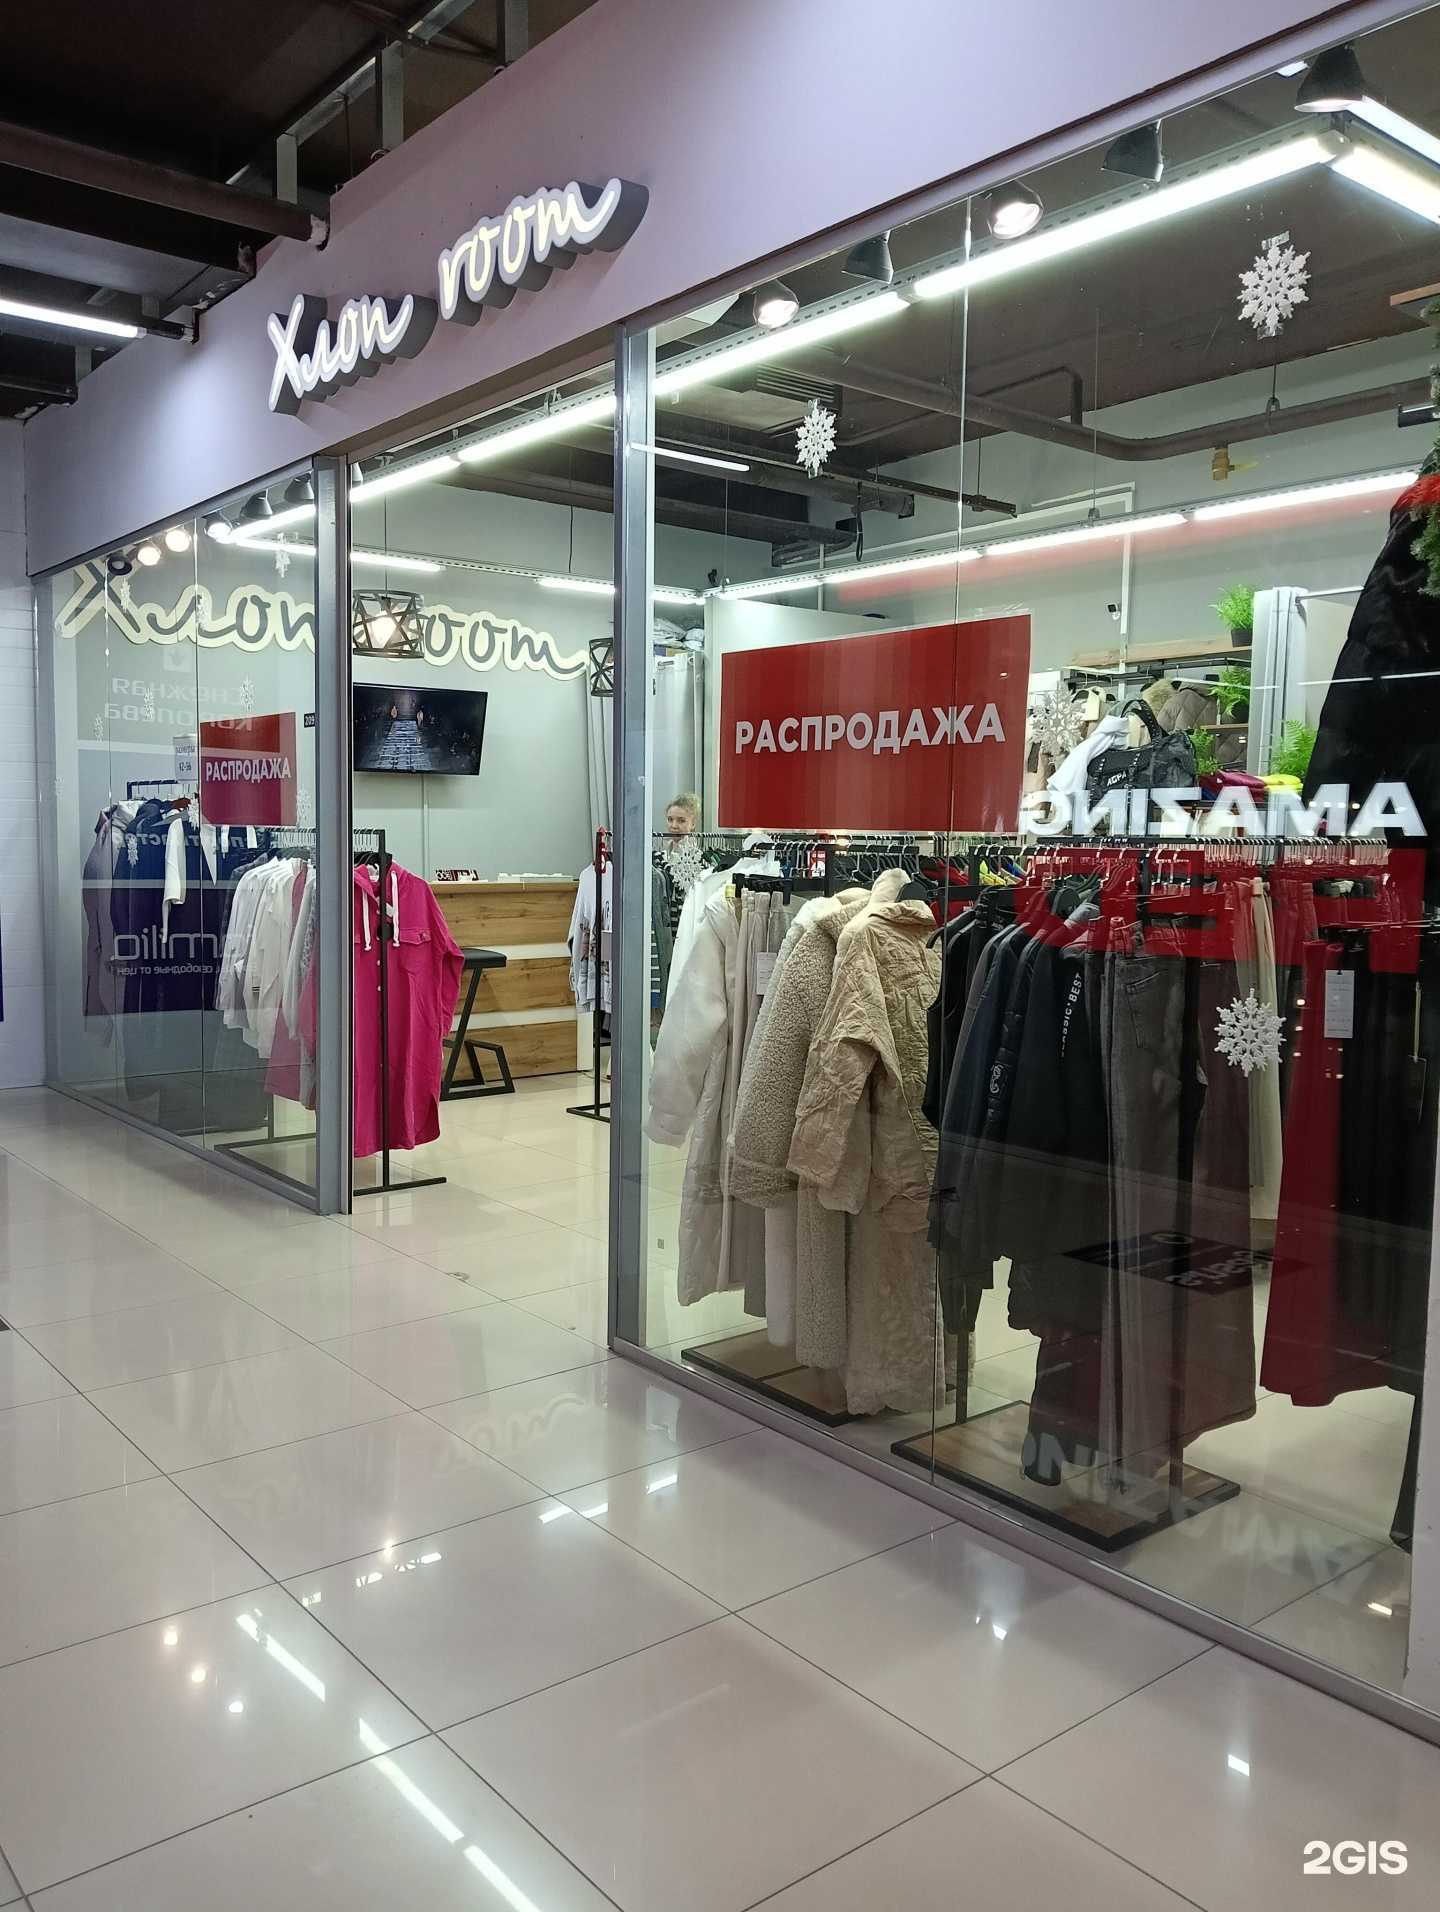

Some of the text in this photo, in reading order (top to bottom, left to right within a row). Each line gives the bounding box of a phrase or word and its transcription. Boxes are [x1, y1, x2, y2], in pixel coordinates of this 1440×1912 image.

[438, 178, 624, 321] room
[413, 606, 588, 678] oom
[735, 703, 1006, 755] РАСПРОДАЖА
[206, 757, 292, 783] РАСПРОДАЖА
[1068, 972, 1083, 1003] BEST
